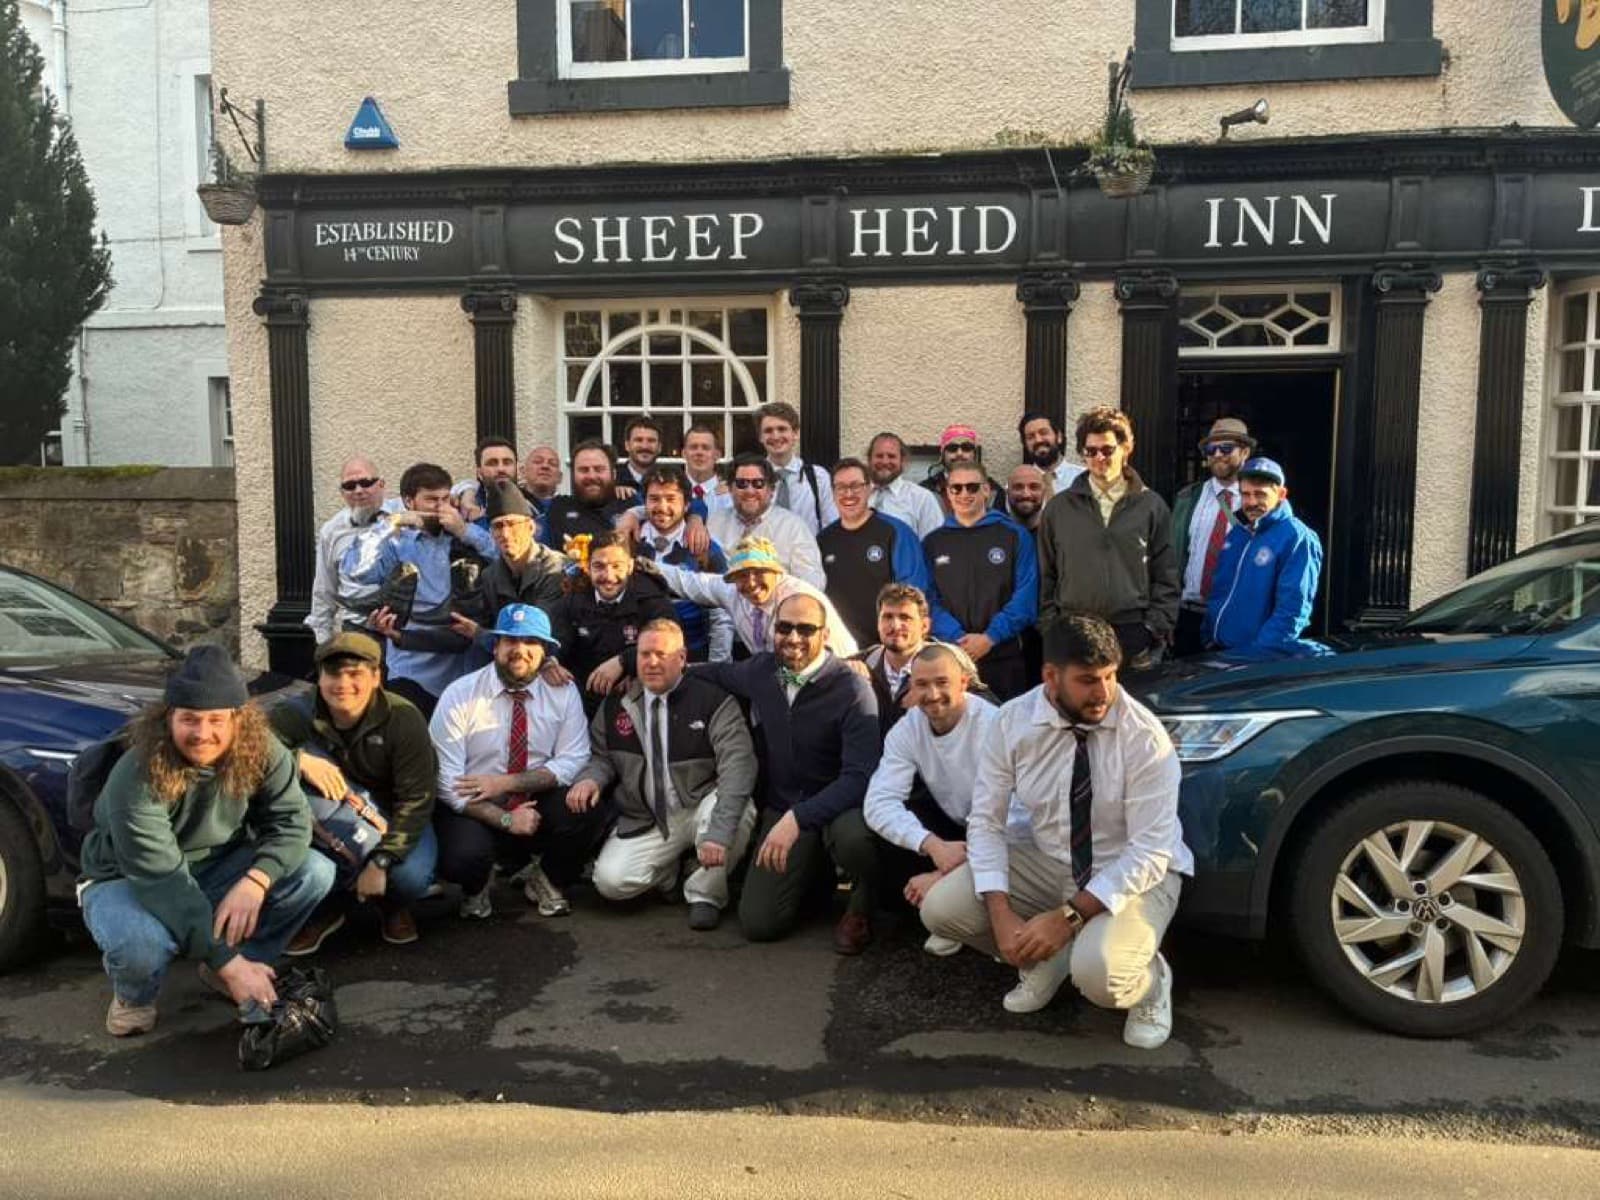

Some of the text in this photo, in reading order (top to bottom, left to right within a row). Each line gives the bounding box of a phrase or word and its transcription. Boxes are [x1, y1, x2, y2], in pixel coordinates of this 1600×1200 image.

[315, 220, 454, 246] ESTABLISHED
[554, 212, 764, 265] SHEEP
[849, 205, 1018, 258] HEID
[1204, 194, 1338, 248] INN
[366, 245, 420, 261] CENTURY
